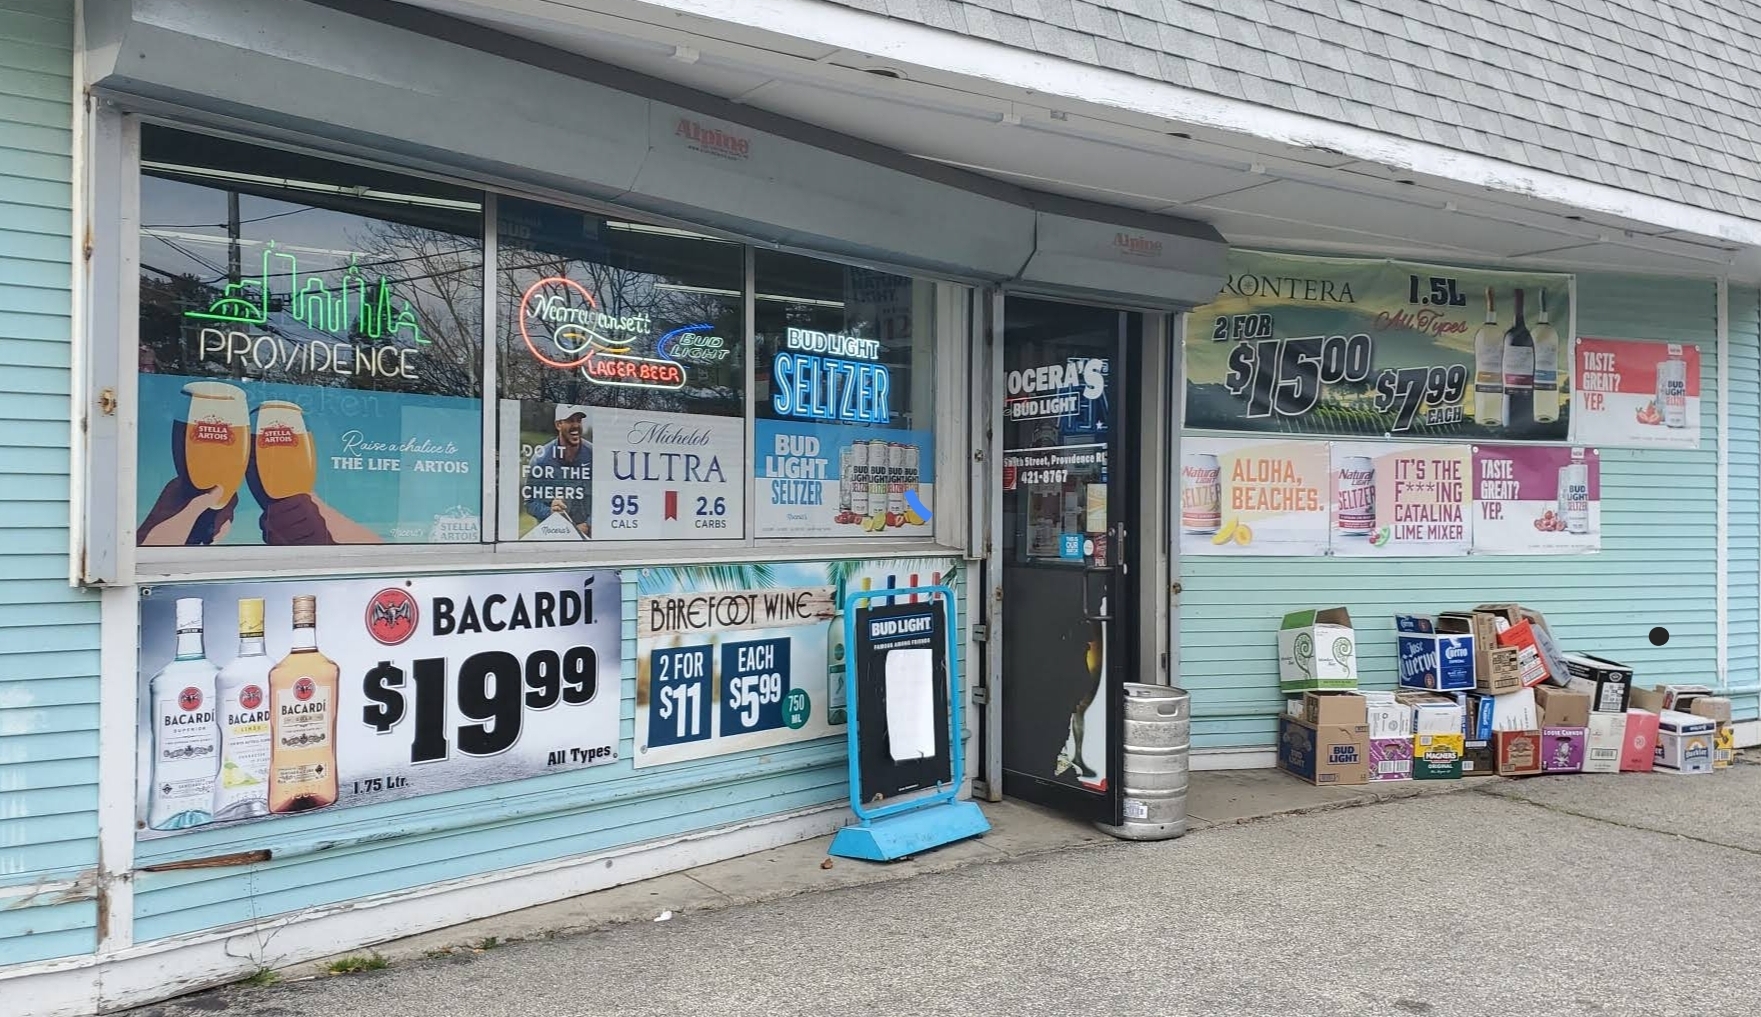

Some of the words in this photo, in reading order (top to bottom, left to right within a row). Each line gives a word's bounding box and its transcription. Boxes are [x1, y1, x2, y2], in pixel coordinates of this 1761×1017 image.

[1219, 273, 1355, 303] RONTERA
[1409, 274, 1467, 307] 1.5L
[1213, 315, 1232, 341] 2
[1232, 313, 1275, 339] FOR
[1373, 309, 1415, 334] All
[1413, 308, 1469, 334] Types
[679, 332, 724, 348] BUD
[787, 327, 828, 352] BUD
[827, 333, 880, 360] LIGHT
[199, 328, 419, 379] PROVIDENCE
[669, 344, 731, 360] LIGHT
[1582, 350, 1616, 372] TASTE
[587, 358, 640, 378] LAGER
[639, 364, 680, 383] BEER
[1004, 358, 1105, 400] OCERA'S
[773, 352, 891, 424] SELTZER
[1582, 370, 1621, 392] GREAT?
[1667, 380, 1684, 388] BUD
[1013, 400, 1039, 417] BUD
[1039, 396, 1078, 415] LIGHT
[1583, 392, 1606, 411] YEP.
[1425, 404, 1464, 426] EACH
[197, 424, 229, 435] STELLA
[197, 431, 229, 441] ARTOIS
[263, 430, 291, 439] STELLA
[263, 434, 293, 444] ARTOIS
[626, 420, 711, 446] Michelob
[341, 429, 387, 457] Raise
[399, 435, 443, 454] chalice
[442, 444, 458, 455] to
[521, 443, 546, 458] DO
[552, 445, 566, 459] IT
[774, 433, 821, 457] BUD
[330, 456, 363, 472] THE
[367, 458, 401, 472] LIFE
[412, 461, 470, 474] ARTOIS
[611, 450, 727, 483] ULTRA
[765, 456, 829, 479] LIGHT
[853, 465, 869, 474] BUD
[1024, 455, 1051, 467] Street,
[1050, 453, 1095, 466] Providence
[1394, 458, 1426, 481] IT'S
[1432, 459, 1462, 481] THE
[1480, 459, 1514, 480] TASTE
[521, 465, 555, 479] FOR
[560, 466, 591, 480] THE
[870, 466, 887, 475] BUD
[887, 467, 903, 475] BUD
[904, 467, 918, 475] BUD
[1021, 469, 1068, 484] 421-8767
[1182, 465, 1221, 479] Natural
[1232, 458, 1303, 487] ALOHA,
[1338, 468, 1376, 480] Natural
[521, 485, 584, 500] CHEERS
[772, 479, 823, 506] SELTZER
[1480, 480, 1520, 500] GREAT?
[1569, 484, 1586, 493] BUD
[611, 494, 640, 516] 95
[695, 496, 727, 516] 2.6
[1231, 486, 1325, 512] BEACHES.
[1394, 504, 1463, 523] CATALINA
[1481, 501, 1504, 520] YEP.
[440, 522, 479, 531] STELLA
[610, 519, 639, 529] CALS
[694, 519, 727, 529] CARBS
[1394, 524, 1424, 540] LIME
[1427, 524, 1463, 540] MIXER
[440, 532, 479, 541] ARTOIS
[432, 574, 596, 637] BACARDÍ
[651, 593, 758, 632] BAREFOOT
[763, 591, 814, 622] WINE
[870, 620, 896, 637] BUD
[898, 615, 932, 635] LIGHT
[659, 655, 669, 682] 2
[673, 651, 704, 680] FOR
[738, 644, 775, 673] EACH
[281, 701, 327, 716] BACARDÍ
[659, 682, 702, 738] $11
[788, 694, 805, 712] 750
[164, 708, 215, 727] BACARDÍ
[228, 709, 270, 726] BACARD
[547, 749, 566, 767] All
[569, 744, 612, 765] Types
[1329, 753, 1359, 763] LIGHT
[1333, 745, 1355, 754] BUD
[1425, 751, 1457, 760] MAGNERS
[353, 774, 382, 795] 1.75
[386, 774, 410, 790] Ltr.
